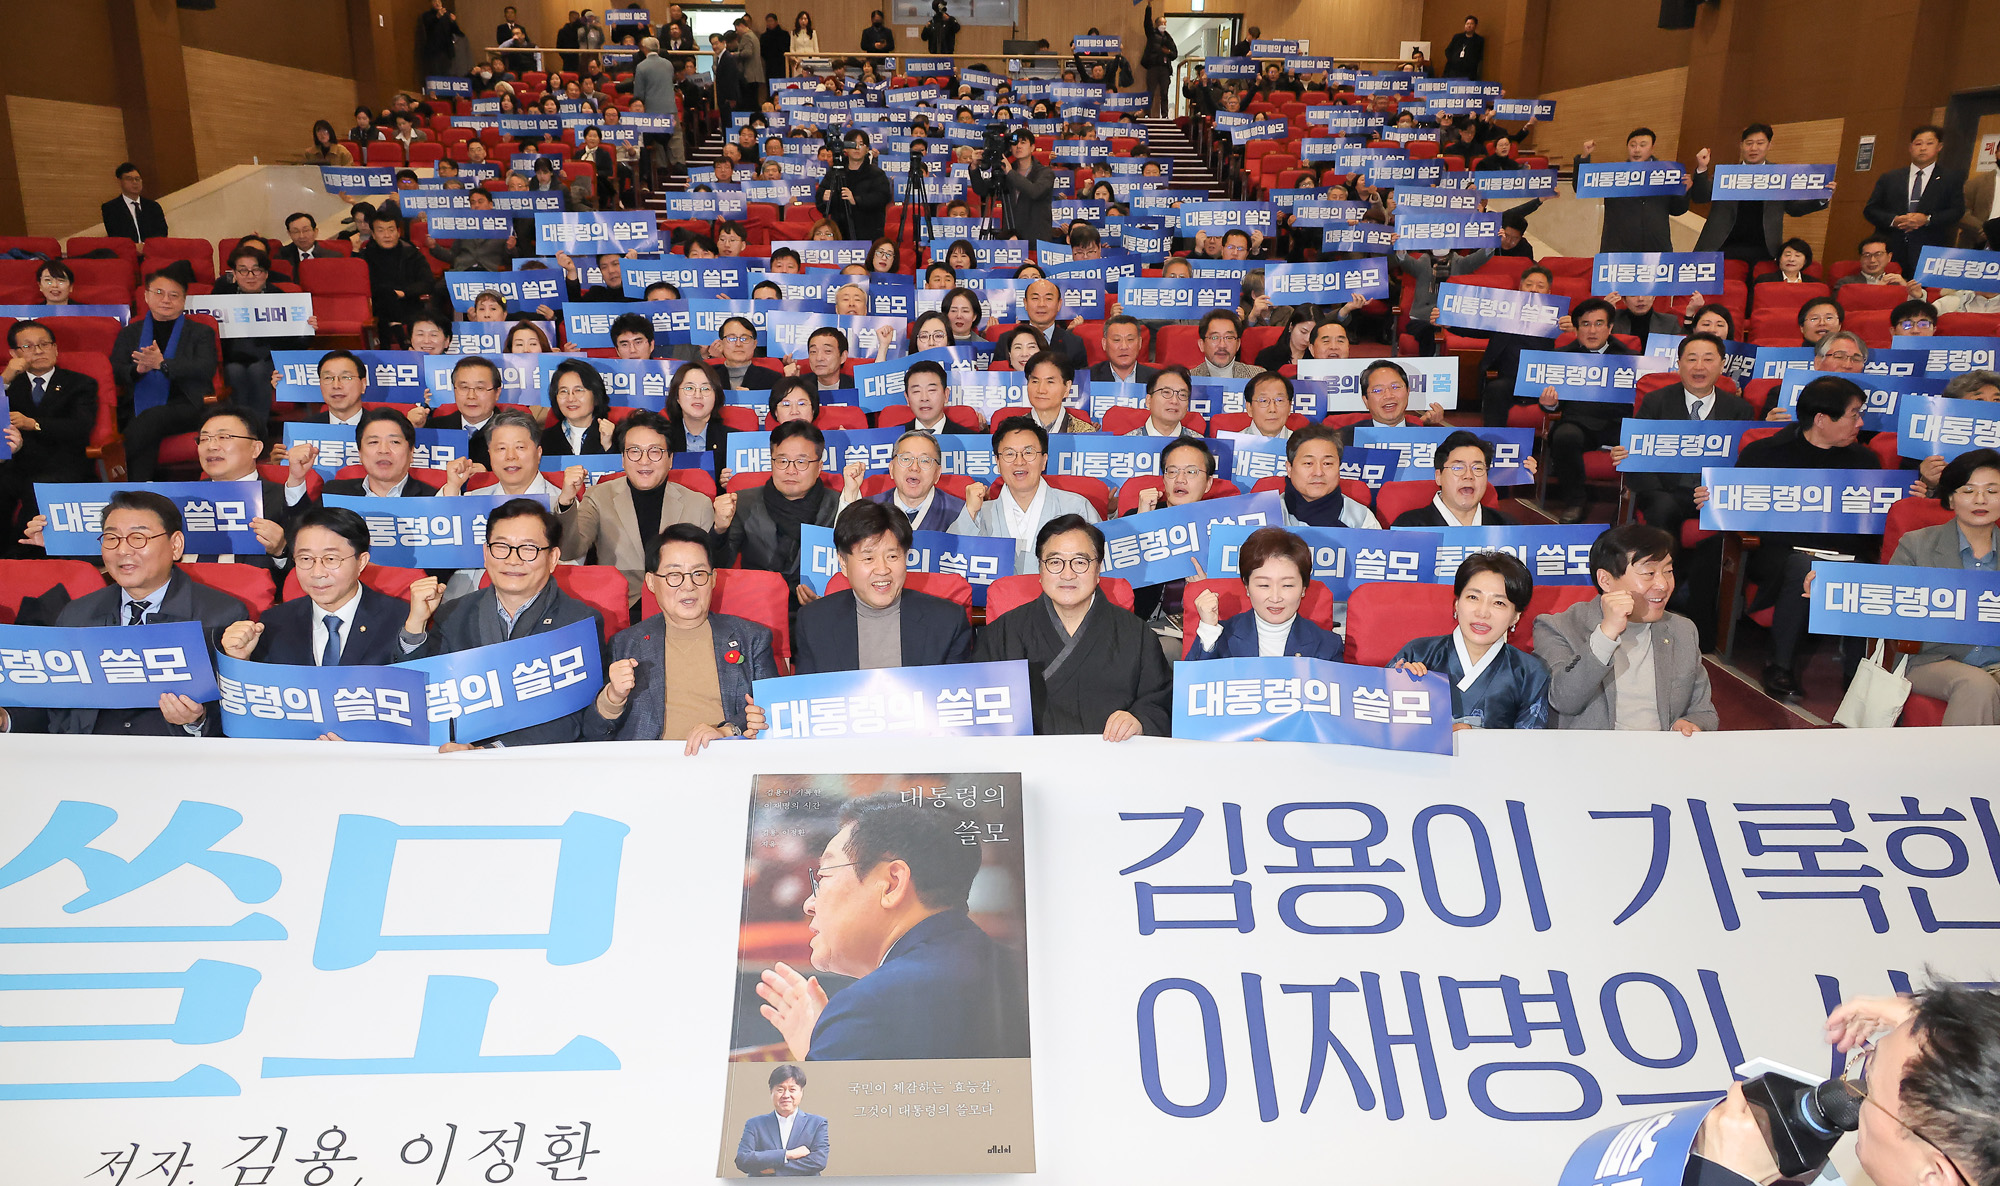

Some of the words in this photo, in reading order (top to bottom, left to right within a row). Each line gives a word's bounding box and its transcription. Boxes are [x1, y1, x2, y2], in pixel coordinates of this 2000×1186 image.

[1534, 104, 1552, 115] 쓸모
[1368, 118, 1384, 126] 쓸모
[1054, 146, 1088, 156] 대통령의
[1090, 146, 1108, 156] 쓸모
[324, 174, 364, 186] 대통령의
[368, 174, 392, 186] 쓸모
[1369, 168, 1414, 180] 대통령의
[1418, 166, 1440, 179] 쓸모
[1584, 170, 1646, 187] 대통령의
[1650, 170, 1682, 186] 쓸모
[1720, 174, 1786, 190] 대통령의
[1790, 173, 1826, 190] 쓸모
[791, 185, 811, 197] 쓸모
[942, 183, 962, 195] 쓸모
[1478, 178, 1526, 191] 대통령의
[1528, 176, 1552, 189] 쓸모
[536, 198, 559, 209] 쓸모
[670, 200, 715, 212] 대통령의
[718, 200, 742, 212] 쓸모
[1398, 194, 1448, 208] 대통령의
[1450, 196, 1475, 209] 쓸모
[1077, 207, 1100, 220] 쓸모
[1186, 210, 1240, 226] 대통령의
[1244, 210, 1270, 226] 쓸모
[1296, 206, 1339, 219] 대통령의
[432, 218, 479, 230] 대통령의
[482, 218, 507, 230] 쓸모
[542, 222, 608, 242] 대통령의
[613, 222, 648, 240] 쓸모
[1400, 224, 1460, 238] 대통령의
[1464, 222, 1495, 238] 쓸모
[1326, 230, 1364, 243] 대통령의
[1367, 232, 1392, 245] 쓸모
[838, 250, 865, 264] 쓸모
[994, 248, 1022, 263] 쓸모
[628, 270, 698, 288] 대통령의
[703, 270, 739, 287] 쓸모
[1106, 264, 1135, 284] 쓸모
[1272, 274, 1340, 292] 대통령의
[1344, 269, 1380, 288] 쓸모
[1598, 264, 1673, 283] 대통령의
[1678, 264, 1716, 282] 쓸모
[522, 281, 559, 299] 쓸모
[1064, 290, 1098, 306] 쓸모
[1124, 289, 1192, 306] 대통령의
[1198, 288, 1232, 306] 쓸모
[876, 296, 908, 314] 쓸모
[1443, 294, 1516, 320] 대통령의
[1520, 300, 1559, 325] 쓸모
[234, 307, 250, 324] 꿈
[254, 306, 288, 323] 너머
[291, 306, 306, 322] 꿈
[652, 312, 690, 332] 쓸모
[1732, 354, 1755, 377] 쓸모
[1926, 350, 1995, 372] 통령의
[376, 364, 420, 387] 쓸모
[1432, 373, 1451, 394] 꿈
[1525, 362, 1609, 388] 대통령의
[844, 442, 895, 468] 쓸모
[1629, 434, 1732, 458] 대통령의
[1059, 450, 1160, 476] 대통령의
[1713, 484, 1832, 513] 대통령의
[1841, 485, 1902, 514] 쓸모
[184, 500, 249, 531] 쓸모
[940, 551, 998, 585] 쓸모
[1355, 548, 1419, 581] 쓸모
[1825, 582, 1965, 621] 대통령의
[100, 646, 192, 684] 쓸모
[426, 669, 504, 723] 령의
[512, 646, 588, 702] 쓸모
[218, 671, 324, 723] 통령의
[333, 686, 412, 727] 쓸모
[1188, 678, 1341, 716] 대통령의
[1352, 684, 1432, 726] 쓸모
[771, 690, 924, 739] 대통령의
[936, 686, 1014, 728] 쓸모
[900, 785, 1004, 808] 대통령의
[954, 820, 1010, 846] 쓸모
[1118, 799, 1552, 936] 김용이
[1588, 796, 2000, 935] 기록한
[0, 800, 631, 1101] 쓸모
[1136, 968, 1748, 1123] 이재명의
[848, 1082, 887, 1094] 국민이
[893, 1081, 944, 1094] 체감하는
[854, 1104, 894, 1118] 그것이
[898, 1103, 950, 1118] 대통령의
[956, 1103, 994, 1117] 쓸모다
[400, 1121, 600, 1186] 이정환
